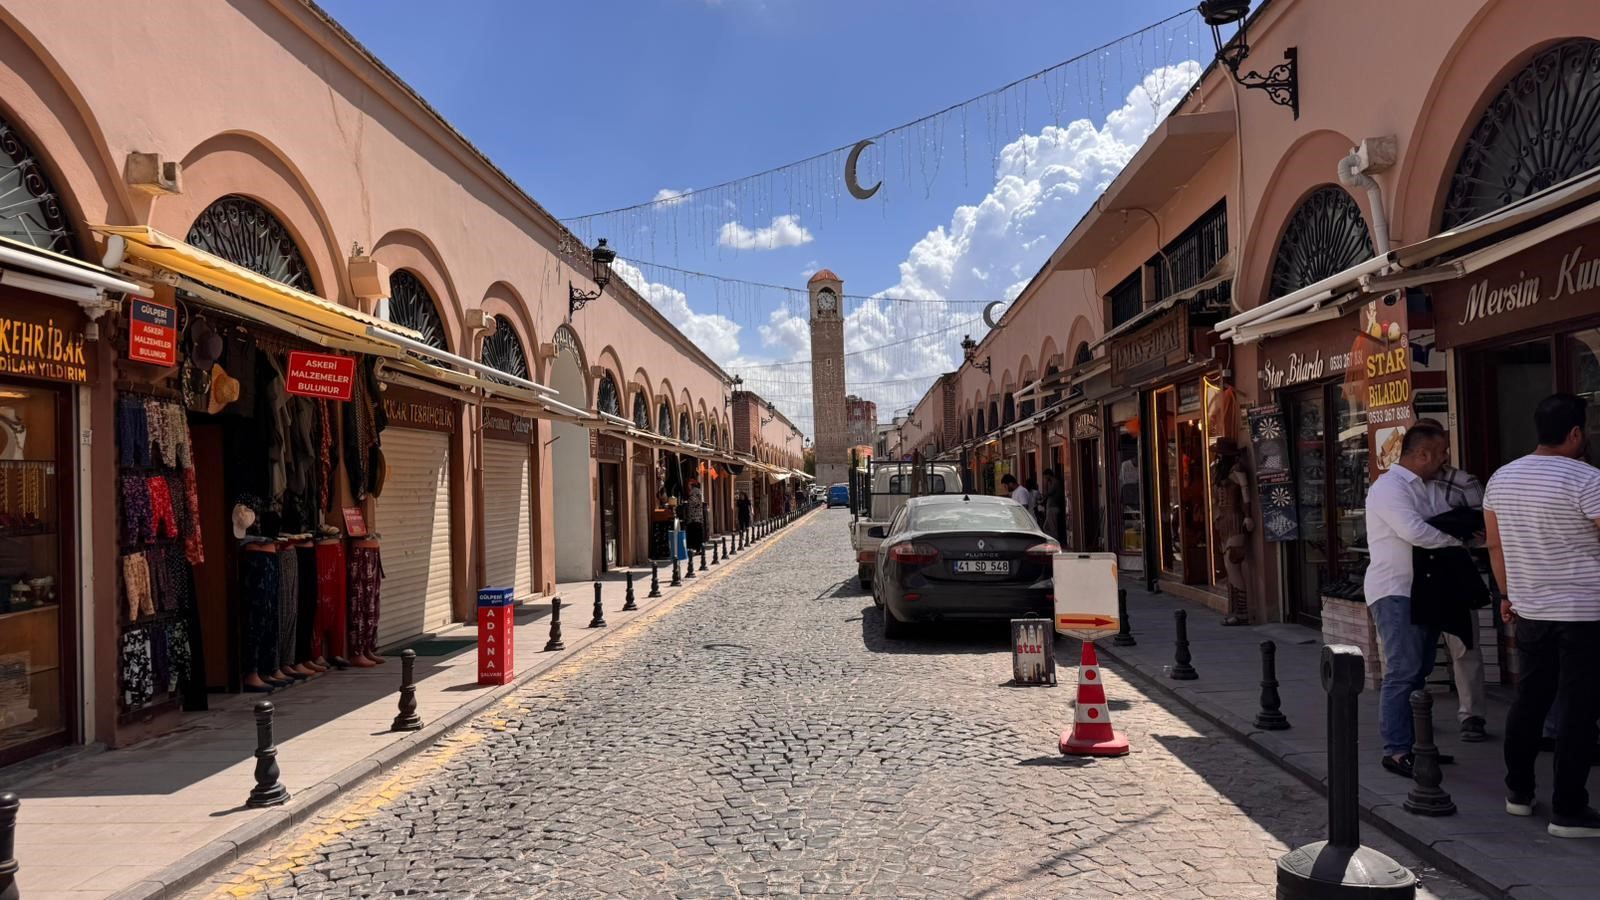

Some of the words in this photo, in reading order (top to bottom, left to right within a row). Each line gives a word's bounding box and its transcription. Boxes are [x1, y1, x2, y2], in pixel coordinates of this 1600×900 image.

[143, 325, 164, 337] ASKERİ
[134, 335, 172, 349] MALZEMELER
[139, 347, 167, 360] BULUNUR
[0, 355, 36, 375] DİLAN
[305, 359, 338, 370] ASKERİ
[1263, 359, 1284, 391] Star
[1286, 349, 1324, 386] Bilardo
[1329, 354, 1343, 371] 0533
[1366, 348, 1407, 378] STAR
[291, 370, 349, 384] MALZEMELER
[297, 382, 340, 395] BULUNUR
[1368, 409, 1384, 424] 0533
[1384, 407, 1395, 422] 267
[958, 561, 970, 571] 41
[975, 561, 987, 571] SD
[990, 561, 1008, 571] 548
[487, 608, 496, 669] ADANA
[1017, 642, 1042, 654] star
